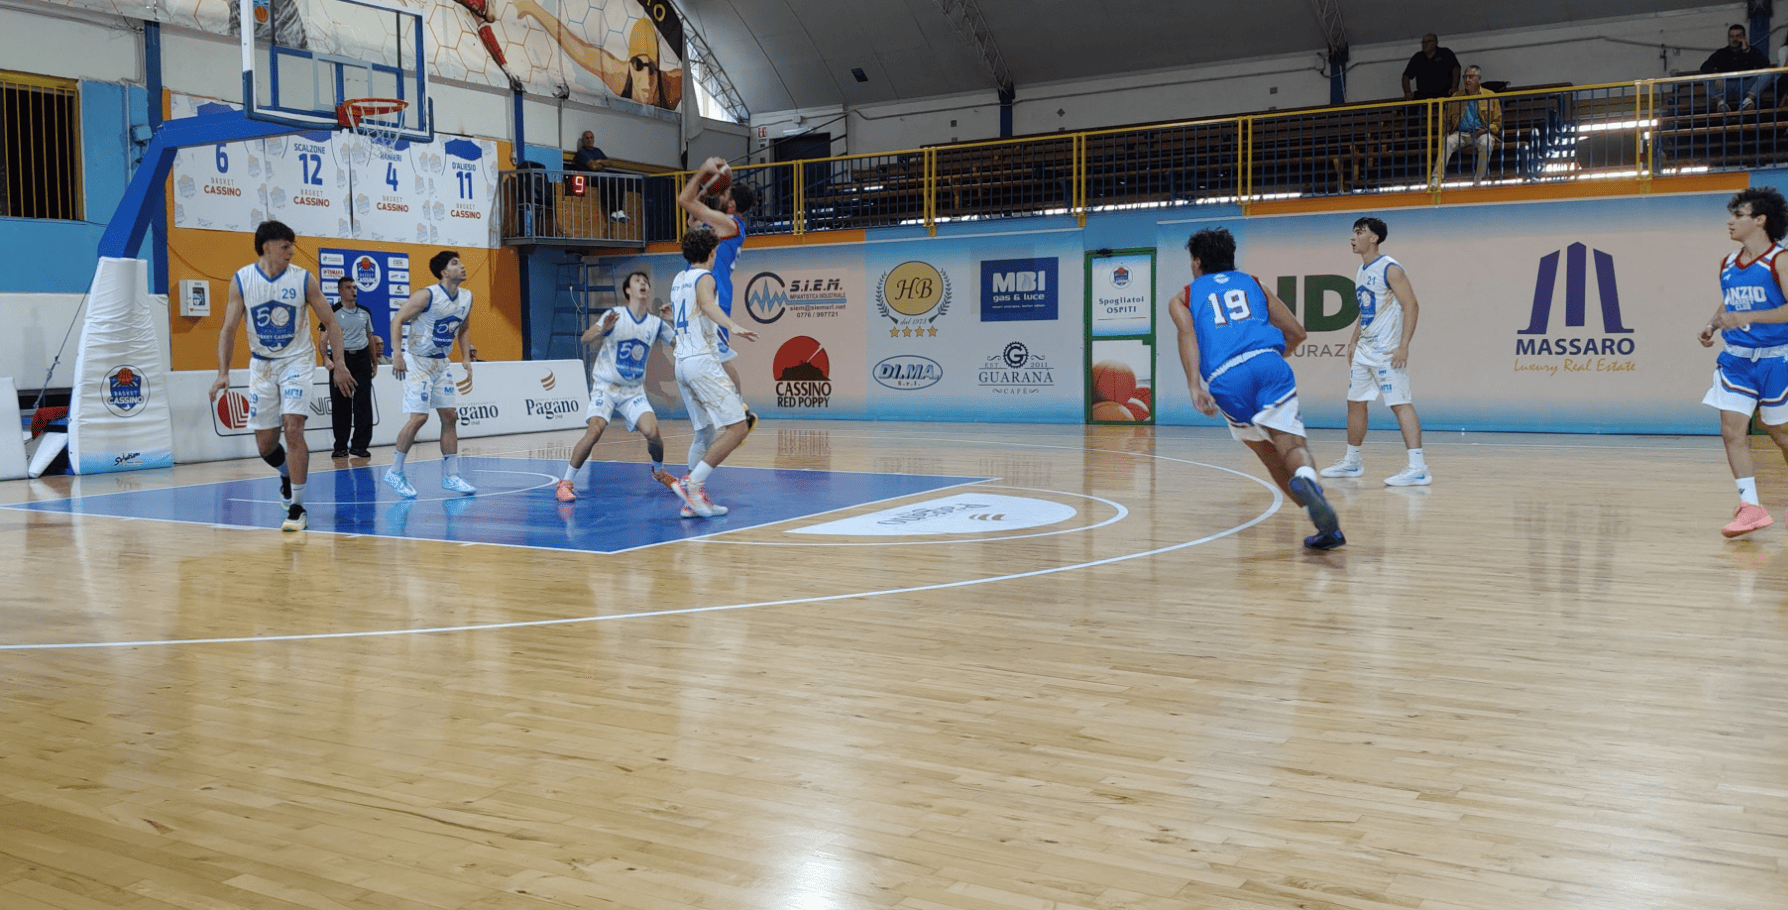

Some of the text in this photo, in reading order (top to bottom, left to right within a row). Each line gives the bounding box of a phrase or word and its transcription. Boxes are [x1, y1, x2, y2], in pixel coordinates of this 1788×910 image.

[294, 142, 326, 155] SCALZONE
[215, 142, 229, 174] 6
[298, 153, 324, 186] 12
[452, 161, 476, 172] D'ALIESIO
[210, 177, 234, 187] BASKET
[386, 161, 398, 192] 4
[203, 184, 242, 197] CASSINO
[456, 170, 473, 200] 11
[575, 175, 584, 193] 9
[300, 188, 324, 197] BASKET
[293, 195, 330, 208] CASSINO
[376, 201, 409, 213] CASSINO
[456, 202, 476, 210] BASKET
[450, 209, 482, 220] CASSINO
[992, 270, 1046, 293] MBI
[1366, 275, 1377, 286] 21
[281, 287, 297, 300] 29
[894, 276, 933, 301] HB
[993, 292, 1045, 303] gas & luce
[1098, 296, 1144, 306] Spogliatoi
[790, 304, 847, 312] siem@siemsrl.net
[1106, 305, 1137, 314] OSPITI
[1208, 289, 1252, 326] 19
[1515, 337, 1636, 356] MASSARO
[1030, 361, 1048, 369] 2011
[1513, 357, 1636, 377] Luxury Real Estate
[421, 381, 428, 391] 7
[775, 381, 832, 397] CASSINO
[106, 395, 145, 406] CASSINO
[777, 395, 830, 408] RED POPPY
[524, 398, 580, 420] Pagano
